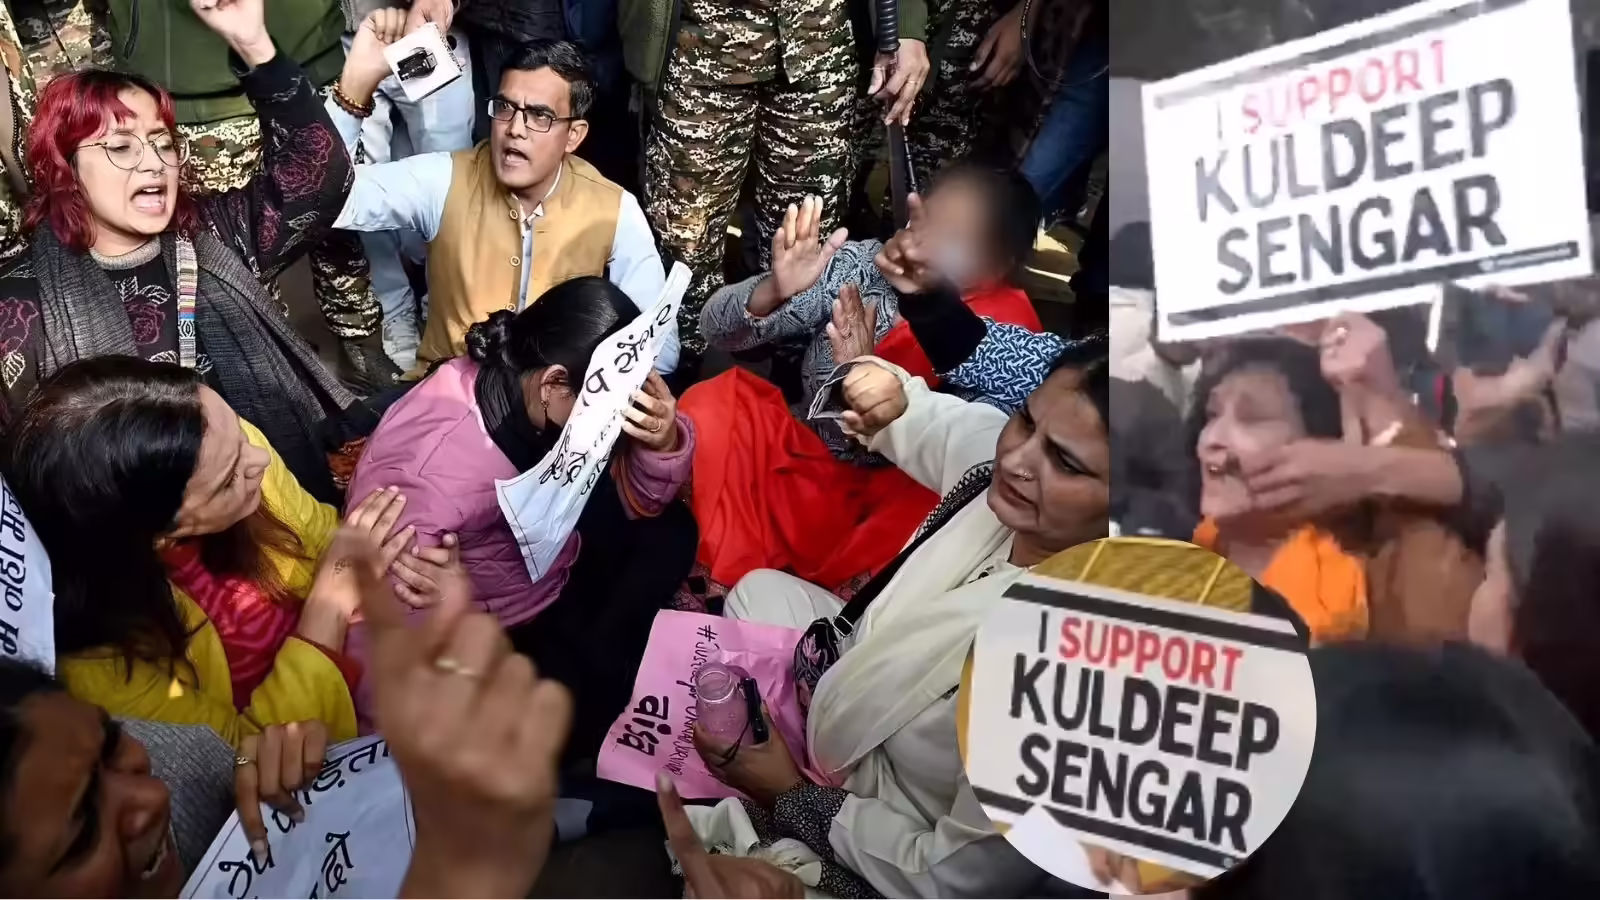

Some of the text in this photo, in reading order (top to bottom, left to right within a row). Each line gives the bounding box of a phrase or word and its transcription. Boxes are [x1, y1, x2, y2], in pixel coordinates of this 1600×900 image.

[1240, 39, 1449, 134] SUPPORT
[1195, 78, 1516, 222] KULDEEP
[1216, 174, 1508, 295] SENGAR
[1038, 610, 1244, 691] I SUPPORT
[616, 695, 672, 757] aisa
[1009, 652, 1280, 771] KULDEEP
[1016, 733, 1252, 853] SENGAR
